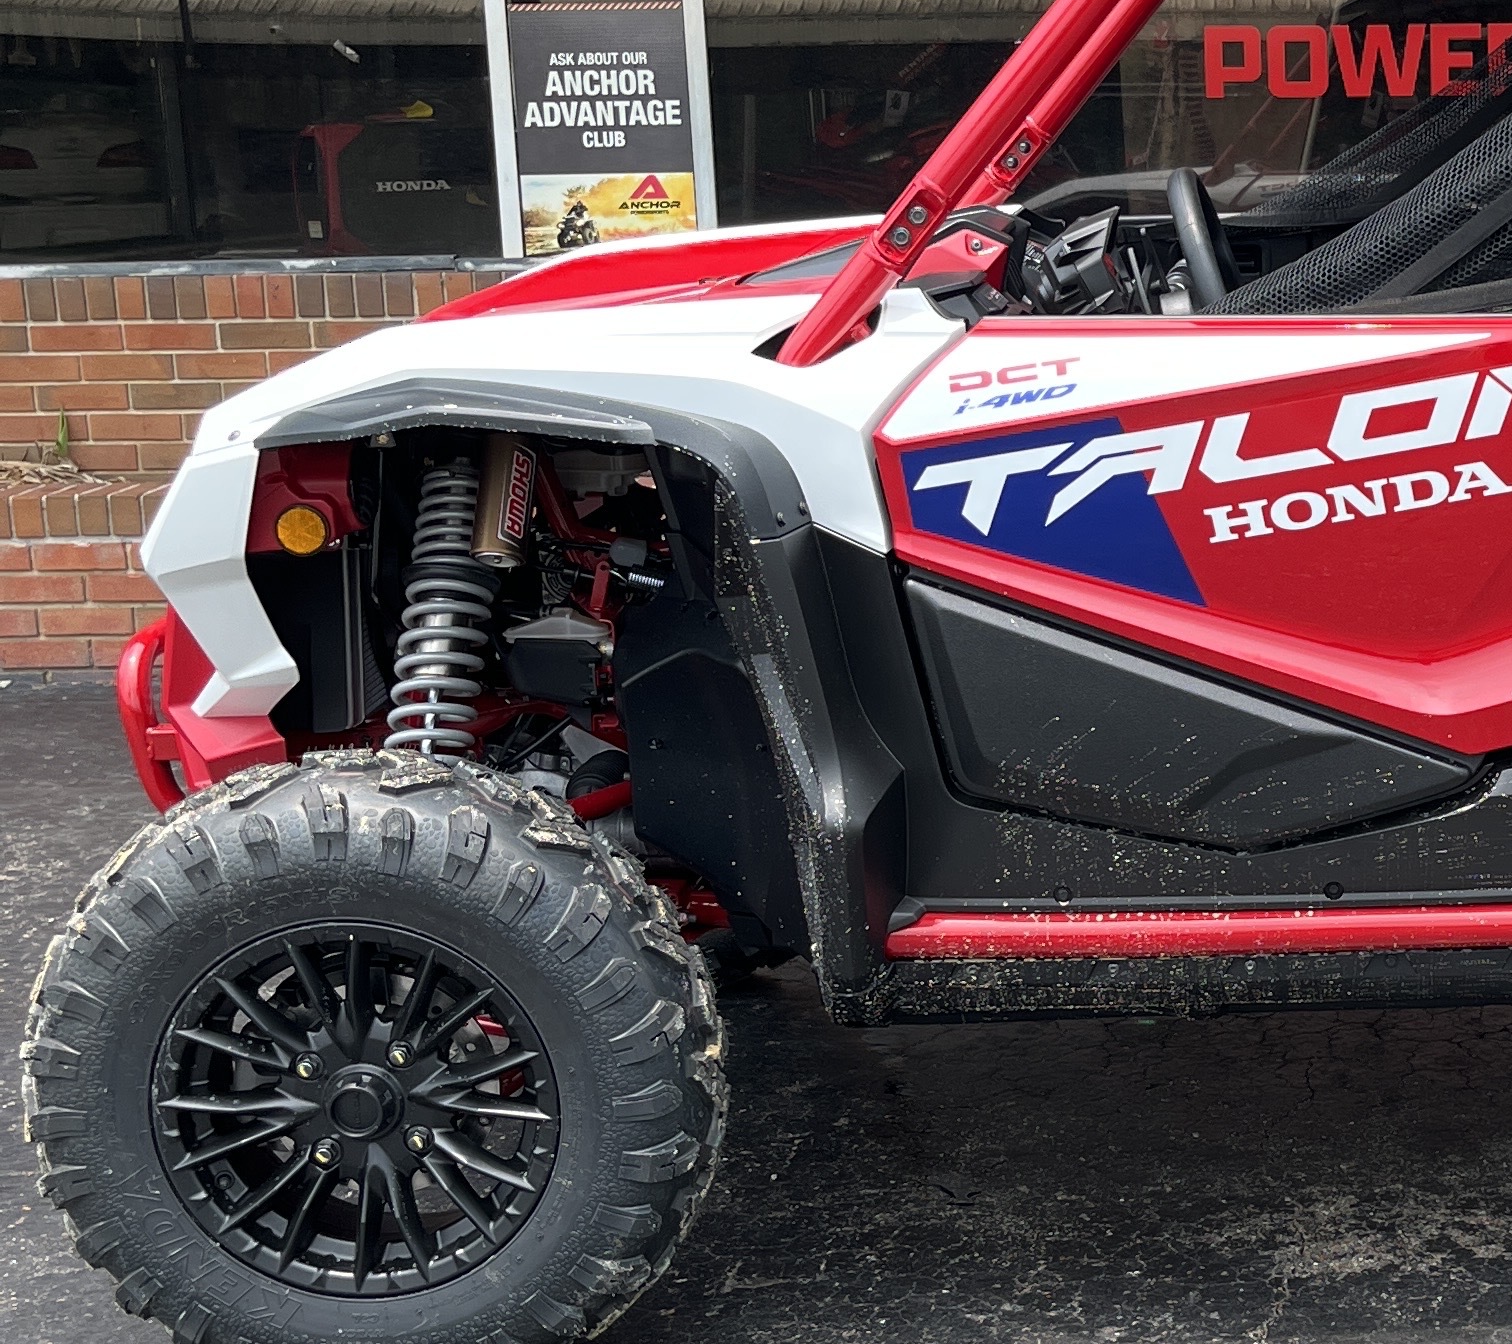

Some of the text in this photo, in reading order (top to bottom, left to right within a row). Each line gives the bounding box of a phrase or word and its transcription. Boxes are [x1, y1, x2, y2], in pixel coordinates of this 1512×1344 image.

[549, 52, 647, 66] ASK ABOUT OUR
[545, 69, 656, 97] ANCHOR
[524, 99, 682, 128] ADVANTAGE
[582, 130, 627, 148] CLUB
[376, 179, 451, 193] HONDA
[618, 201, 681, 210] ANCHOR
[949, 357, 1081, 393] DCT
[504, 450, 532, 539] SHOWA
[109, 1163, 302, 1329] KENDA
